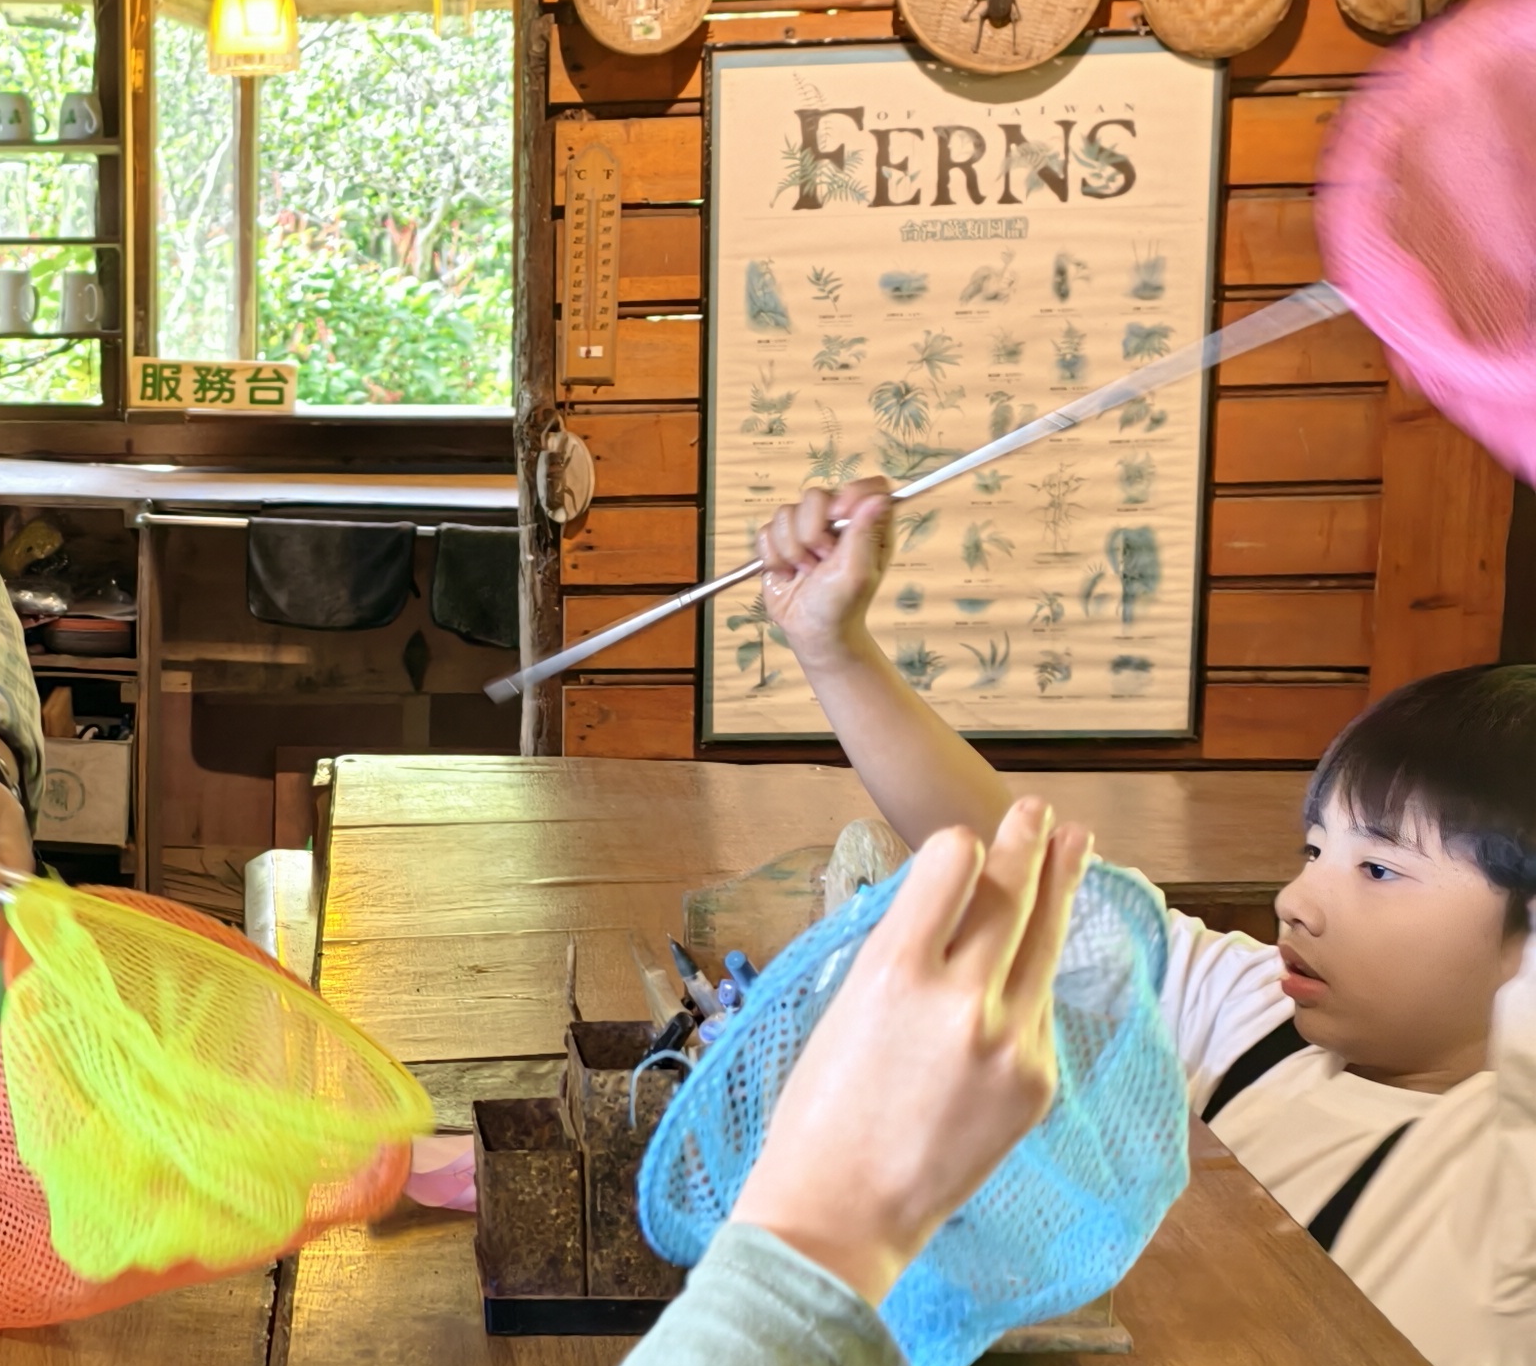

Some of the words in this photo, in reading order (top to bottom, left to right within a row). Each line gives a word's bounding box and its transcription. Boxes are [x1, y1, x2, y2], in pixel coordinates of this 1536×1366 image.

[876, 109, 917, 122] OF
[985, 102, 1137, 119] TAIWAN
[790, 105, 1138, 212] FERNS
[139, 363, 289, 405] 服務台
